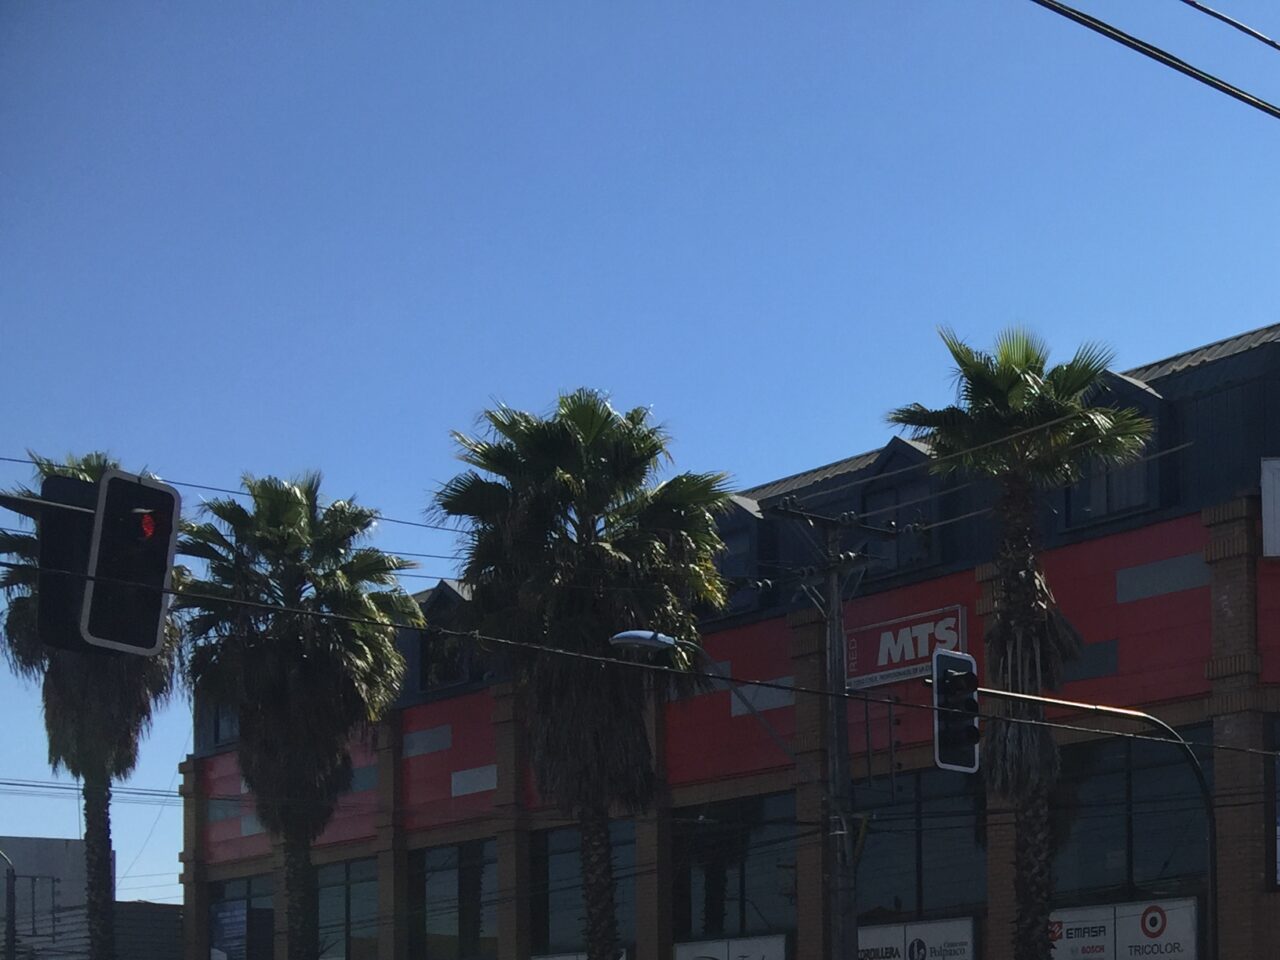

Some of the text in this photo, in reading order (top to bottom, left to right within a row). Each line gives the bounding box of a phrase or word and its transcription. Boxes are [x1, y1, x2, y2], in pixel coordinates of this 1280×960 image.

[877, 616, 959, 666] MTS
[848, 638, 858, 672] RED
[1066, 925, 1106, 939] EMASA
[1081, 944, 1105, 954] BOSCH
[1128, 942, 1181, 956] TRICOLOR
